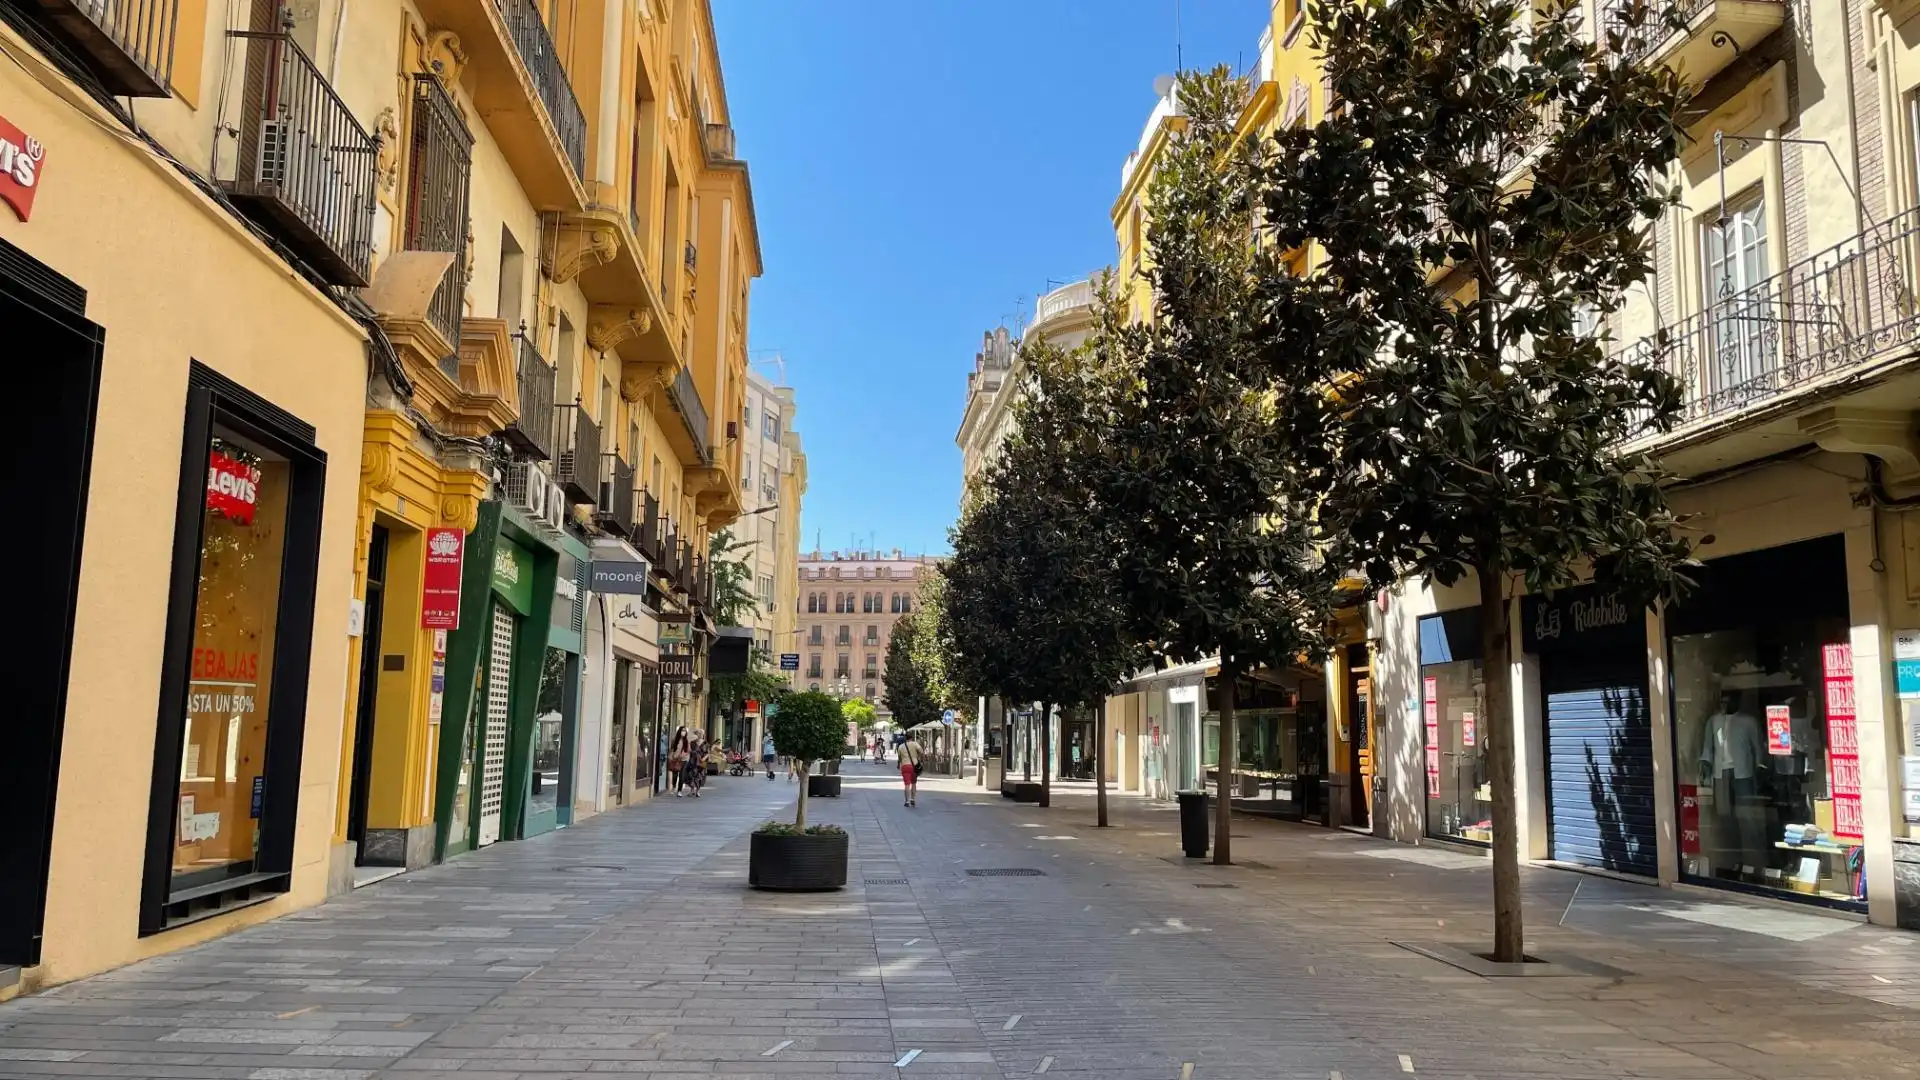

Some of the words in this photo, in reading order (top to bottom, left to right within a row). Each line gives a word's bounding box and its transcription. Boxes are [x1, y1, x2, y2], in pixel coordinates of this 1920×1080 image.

[595, 571, 642, 582] moonë
[192, 648, 257, 679] EBAJAS
[187, 694, 212, 712] ASTA
[216, 694, 230, 712] UN
[232, 695, 255, 712] 50%
